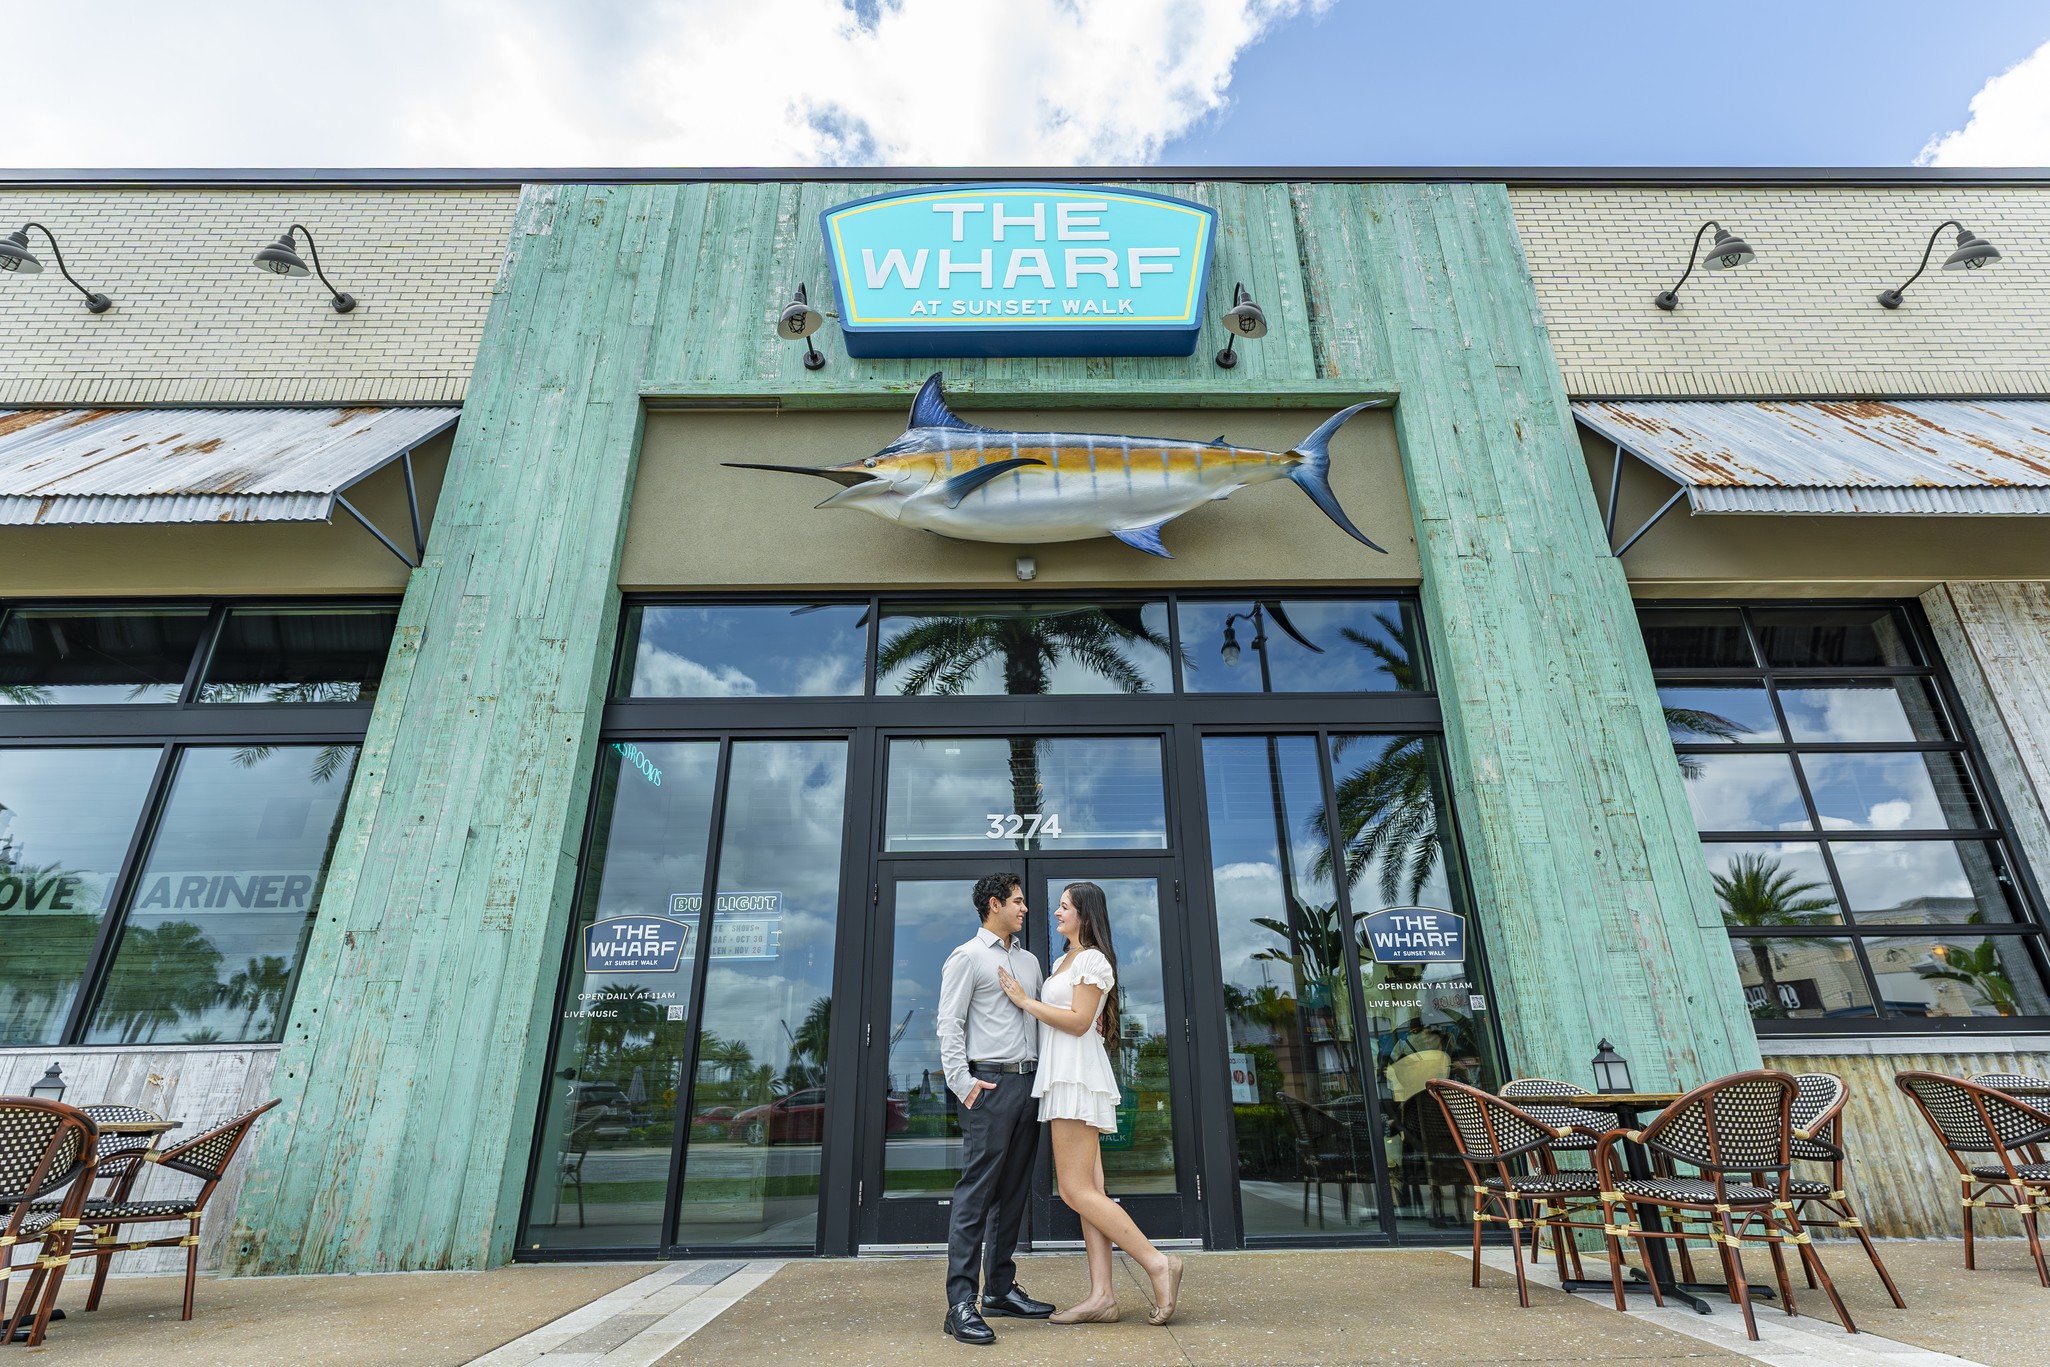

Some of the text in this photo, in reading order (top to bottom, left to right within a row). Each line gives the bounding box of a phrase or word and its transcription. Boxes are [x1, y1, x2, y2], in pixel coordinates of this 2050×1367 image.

[932, 202, 1110, 242] THE
[861, 247, 1181, 290] WHARF
[909, 299, 1135, 315] AT SUNSET WALK
[985, 813, 1062, 839] 3274
[673, 895, 778, 912] BU LIGHT
[1390, 915, 1439, 931] THE
[612, 924, 661, 940] THE
[735, 935, 750, 943] OCT
[1374, 932, 1458, 948] WHARF
[591, 941, 677, 957] WHARF
[734, 946, 749, 954] NOV
[1405, 982, 1432, 990] DAILY
[606, 992, 635, 1000] DAILY
[1369, 1000, 1422, 1008] LIVE MUSIC
[587, 1010, 618, 1018] MUSIC
